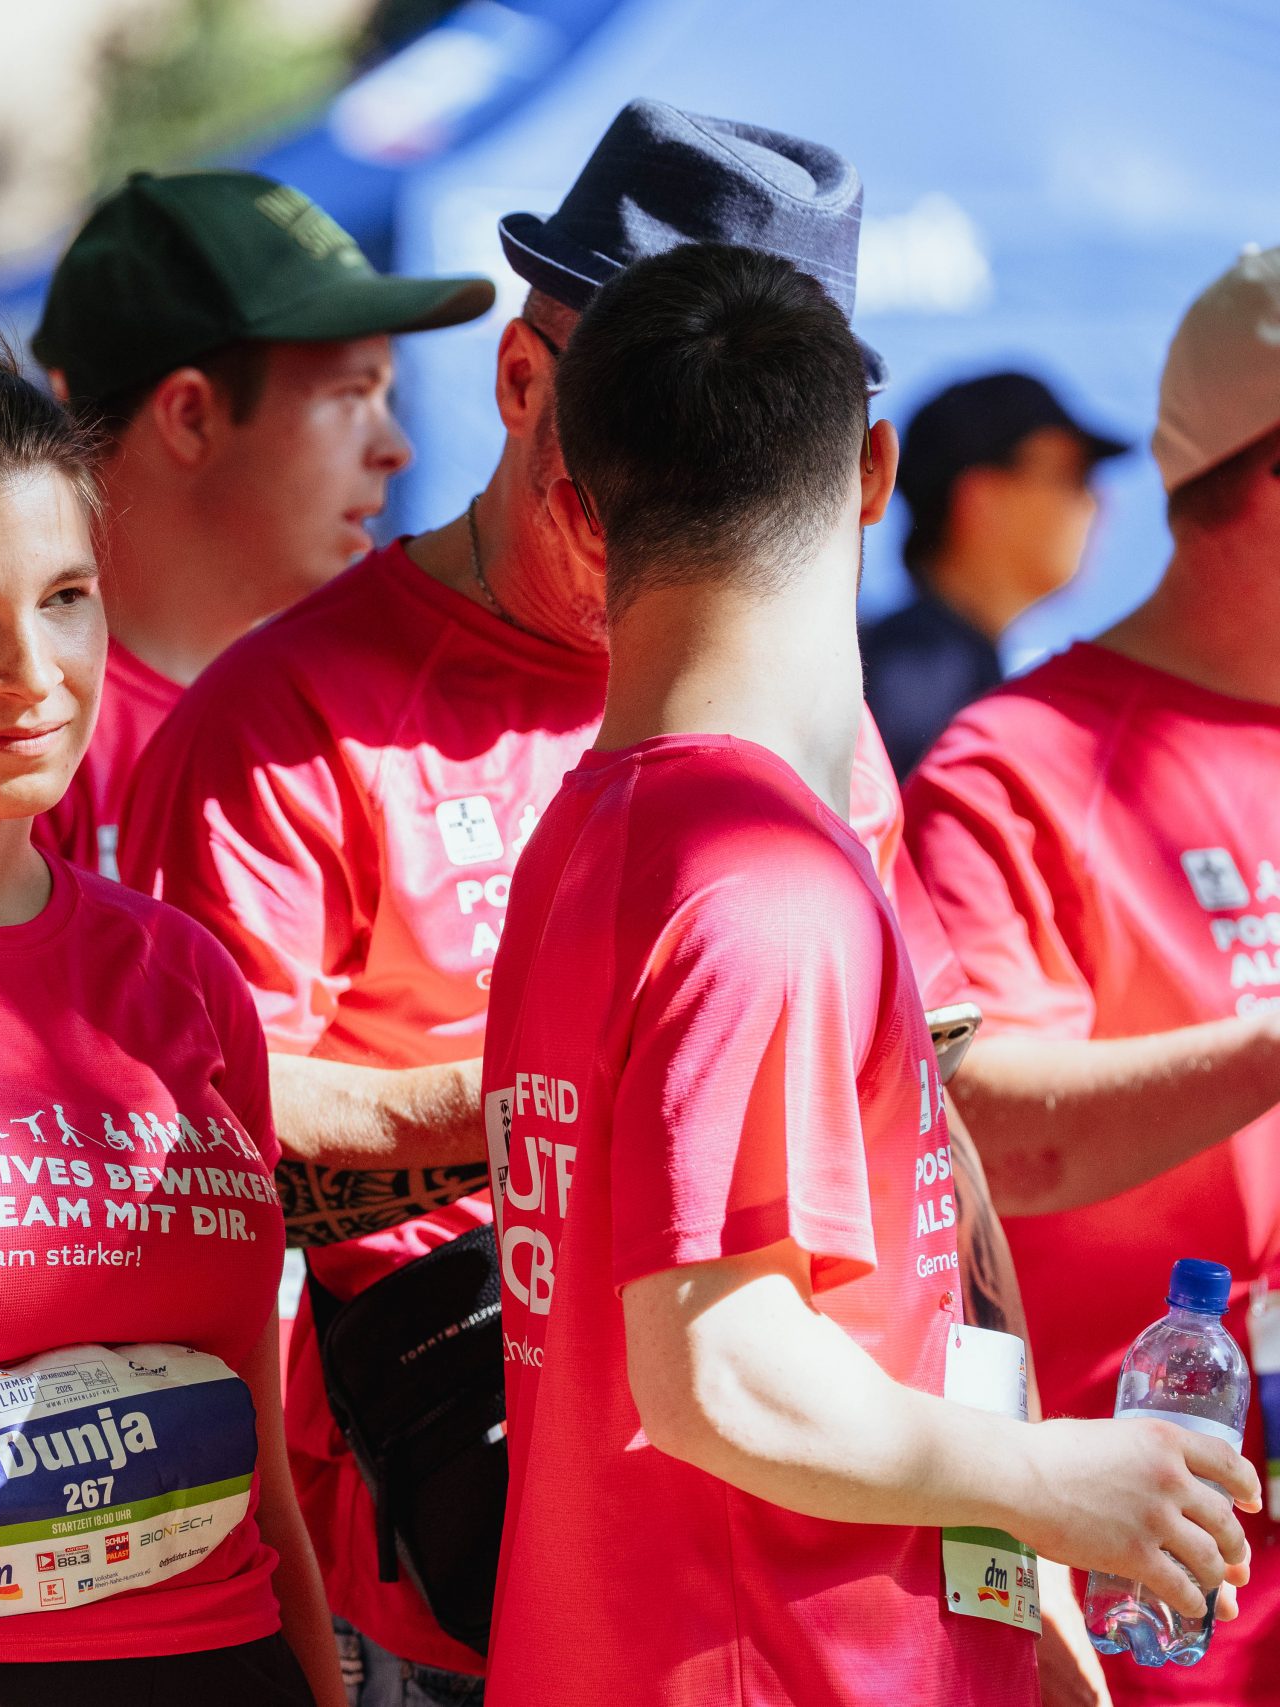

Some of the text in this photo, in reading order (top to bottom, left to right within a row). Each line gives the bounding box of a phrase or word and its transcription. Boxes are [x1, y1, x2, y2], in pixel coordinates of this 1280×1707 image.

[105, 1200, 176, 1234] MIT
[191, 1206, 257, 1241] DIR.
[915, 1195, 956, 1238] ALS
[46, 1241, 142, 1268] stärker!
[48, 1370, 77, 1379] KREUZNACH
[0, 1385, 36, 1407] LAUF
[55, 1384, 73, 1394] 2026
[63, 1476, 114, 1512] 267
[51, 1509, 132, 1535] STARTZEIT 18:00 UHR
[140, 1514, 213, 1546] BIONTECH
[105, 1535, 129, 1546] SCHUH
[58, 1554, 90, 1567] 88.3
[106, 1550, 129, 1561] PALAST
[95, 1572, 119, 1581] Volksbank
[985, 1558, 1007, 1590] dm
